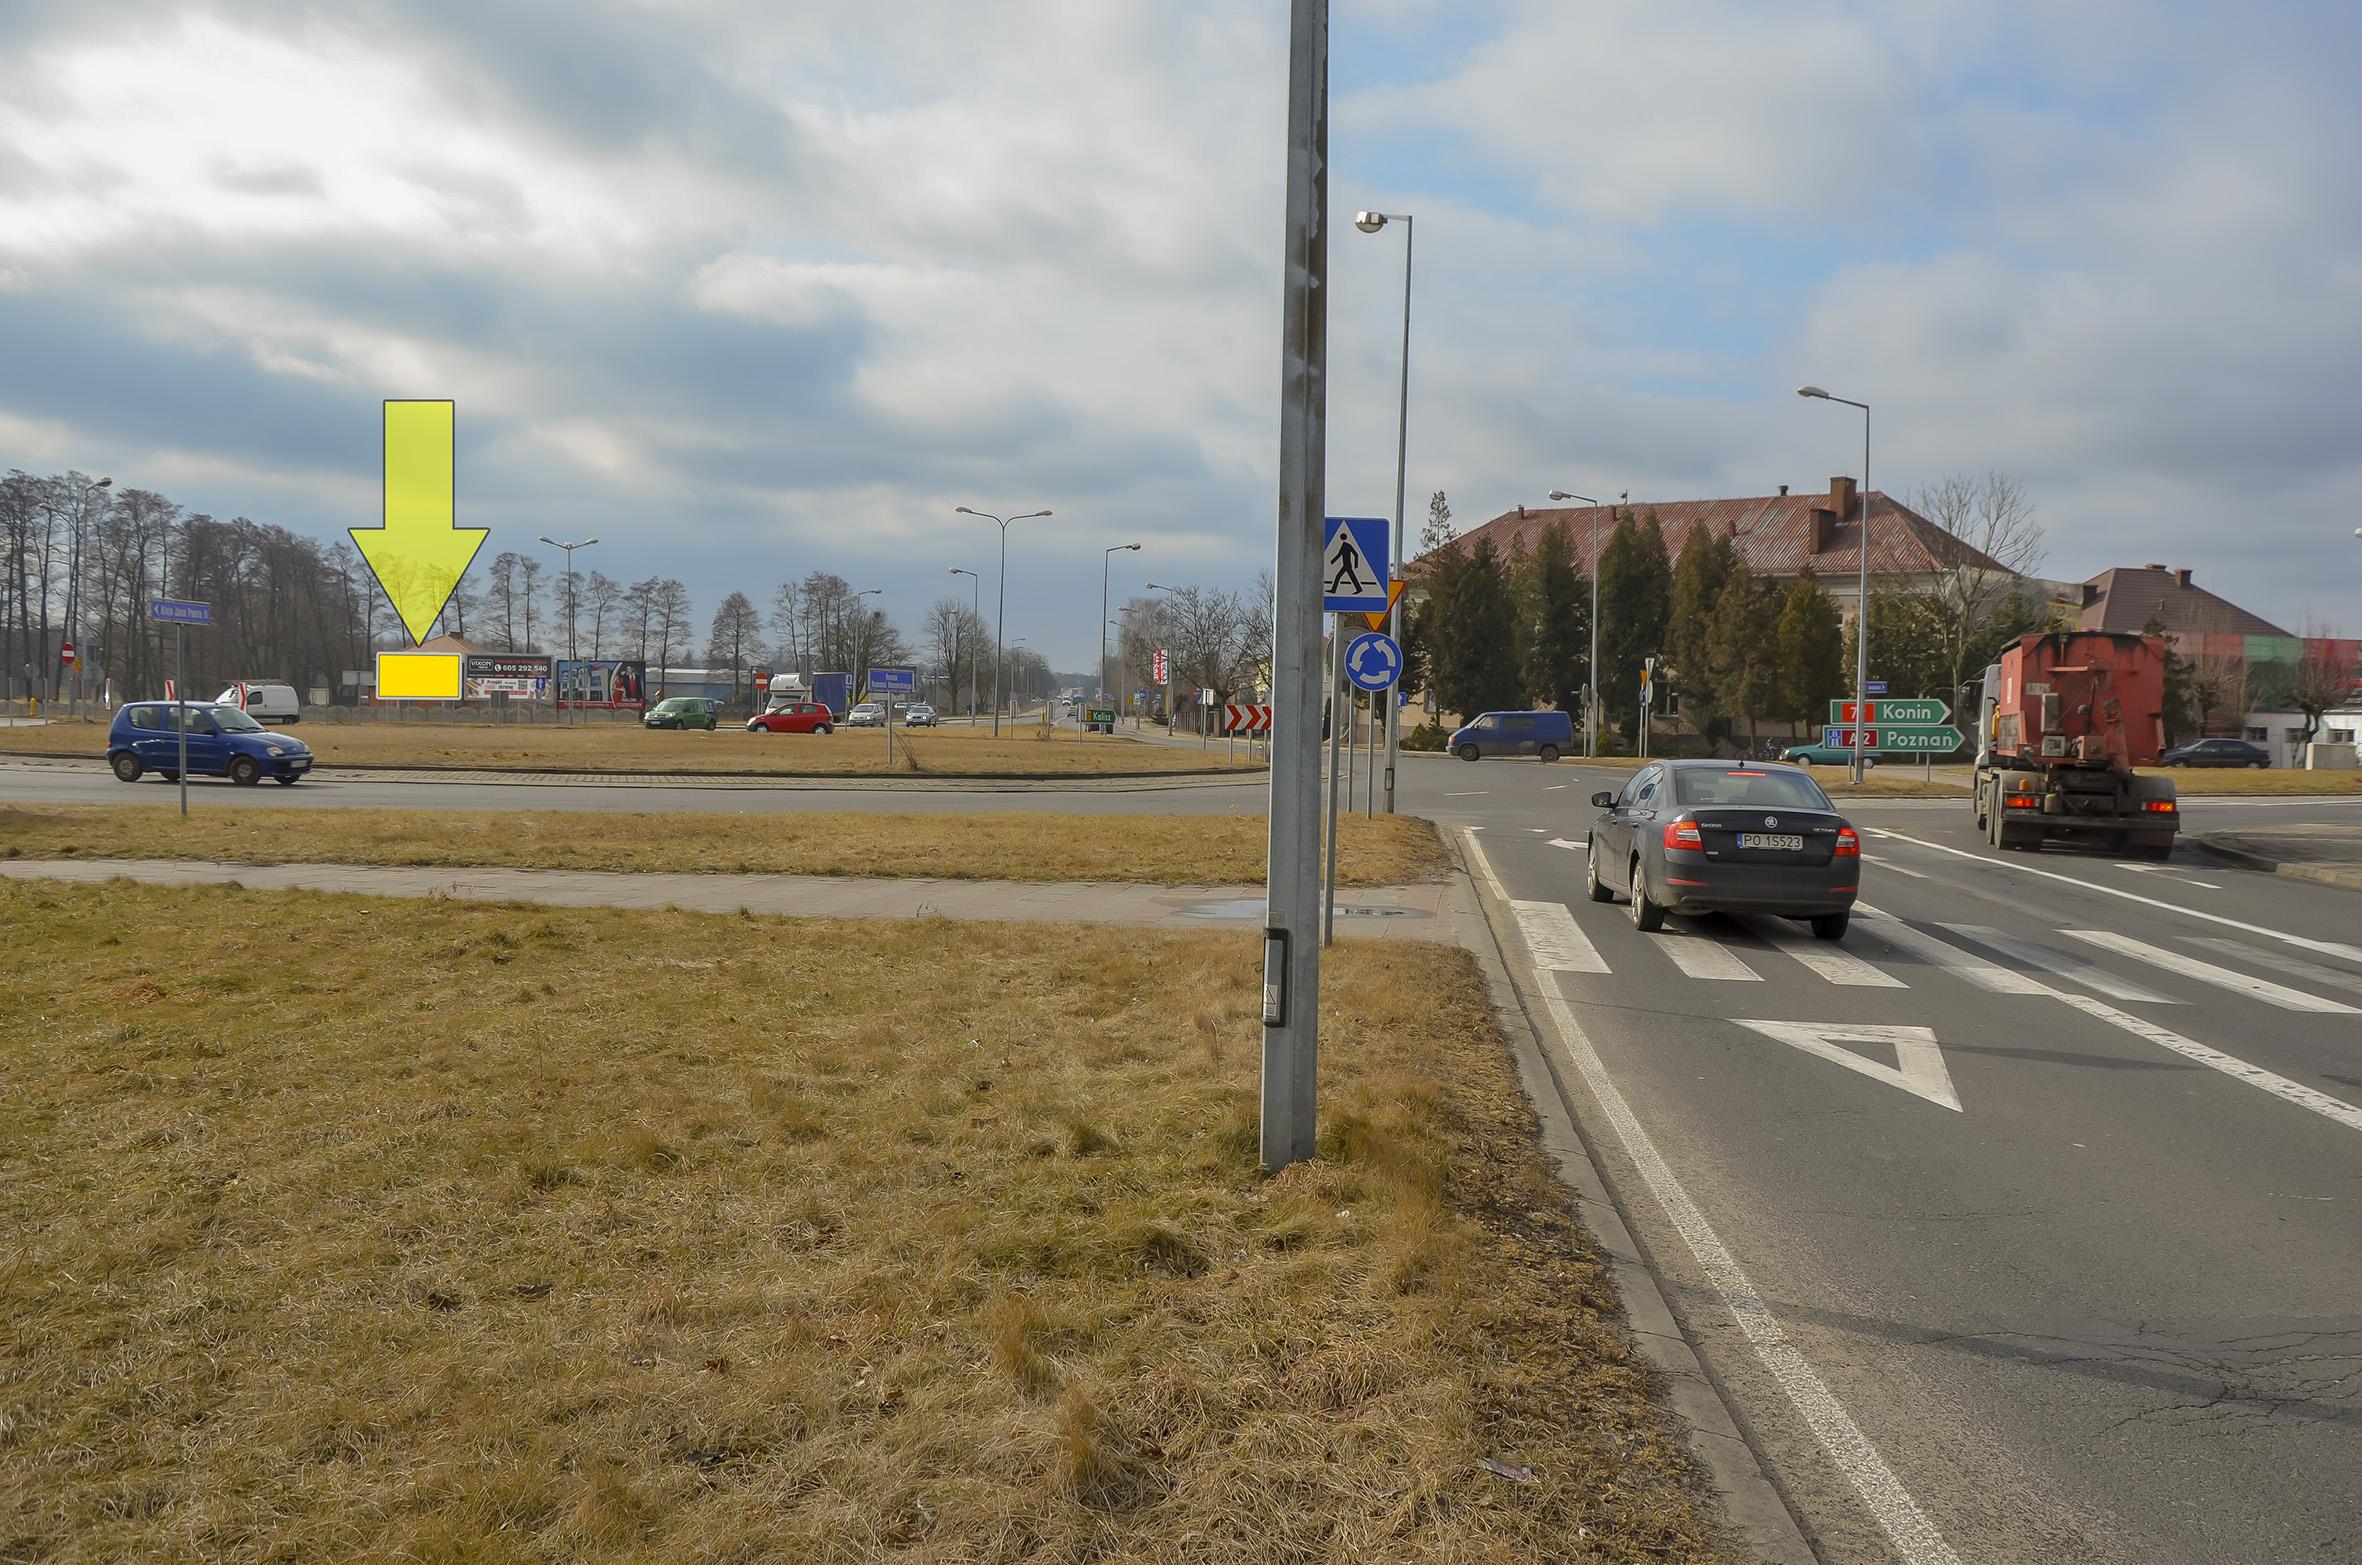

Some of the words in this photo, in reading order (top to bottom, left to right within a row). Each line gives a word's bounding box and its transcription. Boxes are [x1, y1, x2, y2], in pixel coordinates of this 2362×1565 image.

[502, 664, 516, 672] 605
[518, 664, 532, 672] 292
[1093, 711, 1111, 721] Kalisz
[1883, 704, 1931, 719] Konin
[1887, 731, 1953, 747] Poznań
[1744, 834, 1761, 846] PO
[1767, 835, 1801, 848] 1S523
